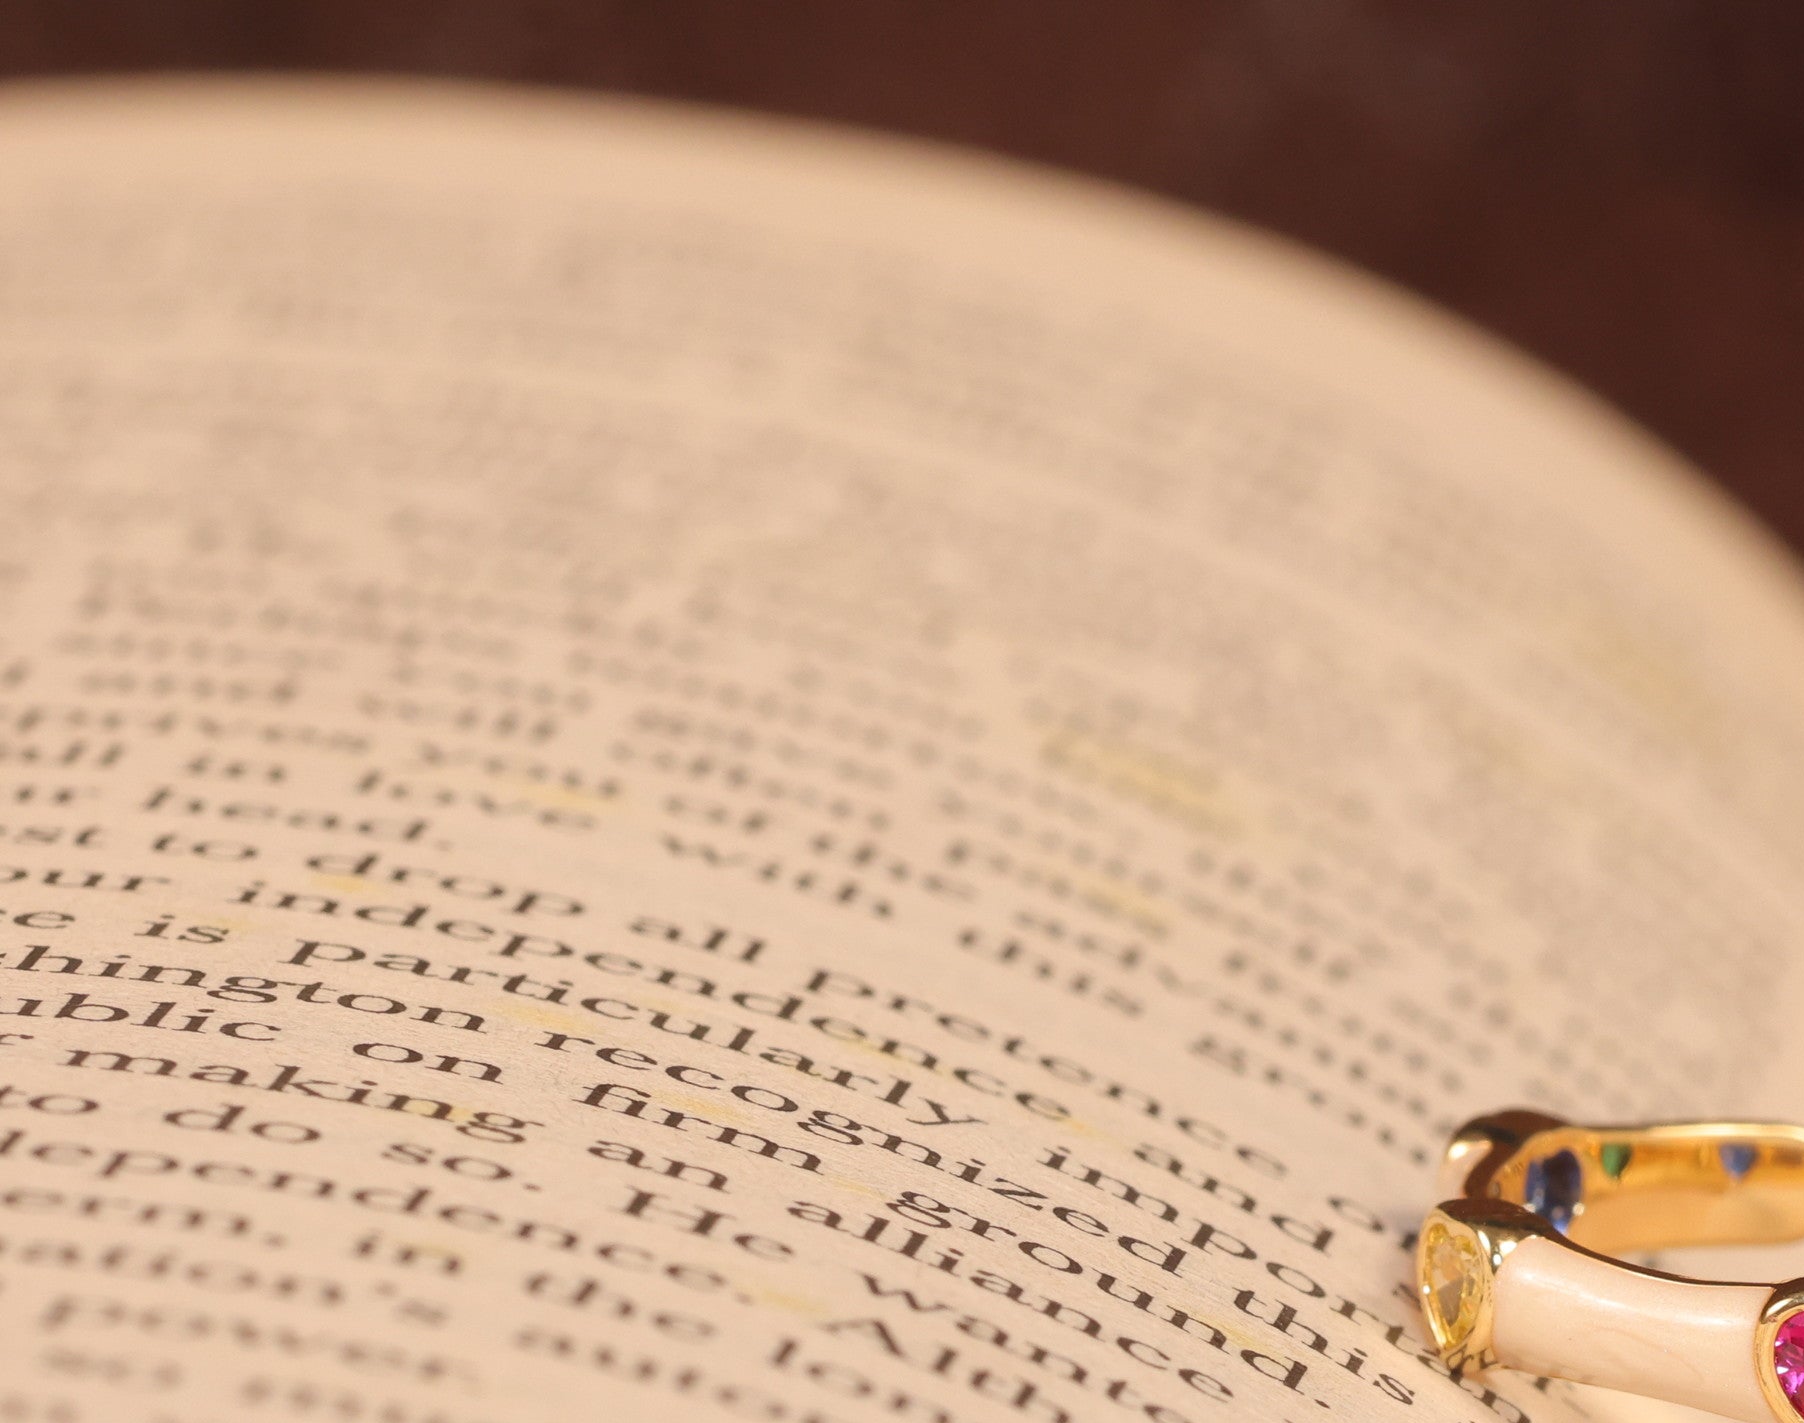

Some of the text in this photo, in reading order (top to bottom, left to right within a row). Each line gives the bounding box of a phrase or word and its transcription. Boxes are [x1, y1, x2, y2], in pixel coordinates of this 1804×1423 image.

[150, 831, 260, 862] to
[306, 851, 586, 917] drop
[626, 914, 769, 964] all
[801, 966, 1289, 1179] pretence
[354, 766, 598, 832] love
[660, 830, 895, 922] with
[0, 944, 488, 1034] hington
[534, 1030, 1192, 1278] recognized
[1232, 1287, 1415, 1405] this
[134, 914, 230, 945] is
[278, 938, 989, 1128] particularly
[163, 1104, 322, 1144] do
[380, 1140, 543, 1192] so.
[610, 1184, 796, 1262] He
[226, 880, 1074, 1121] independence
[1129, 1141, 1337, 1256] and
[58, 1049, 544, 1146] making
[587, 1137, 733, 1193] an
[785, 1198, 1235, 1402] alliance
[352, 1230, 466, 1279] in
[522, 1268, 720, 1342] the
[353, 1043, 505, 1087] on
[571, 1082, 825, 1176] firm
[887, 1187, 1332, 1410] ground.
